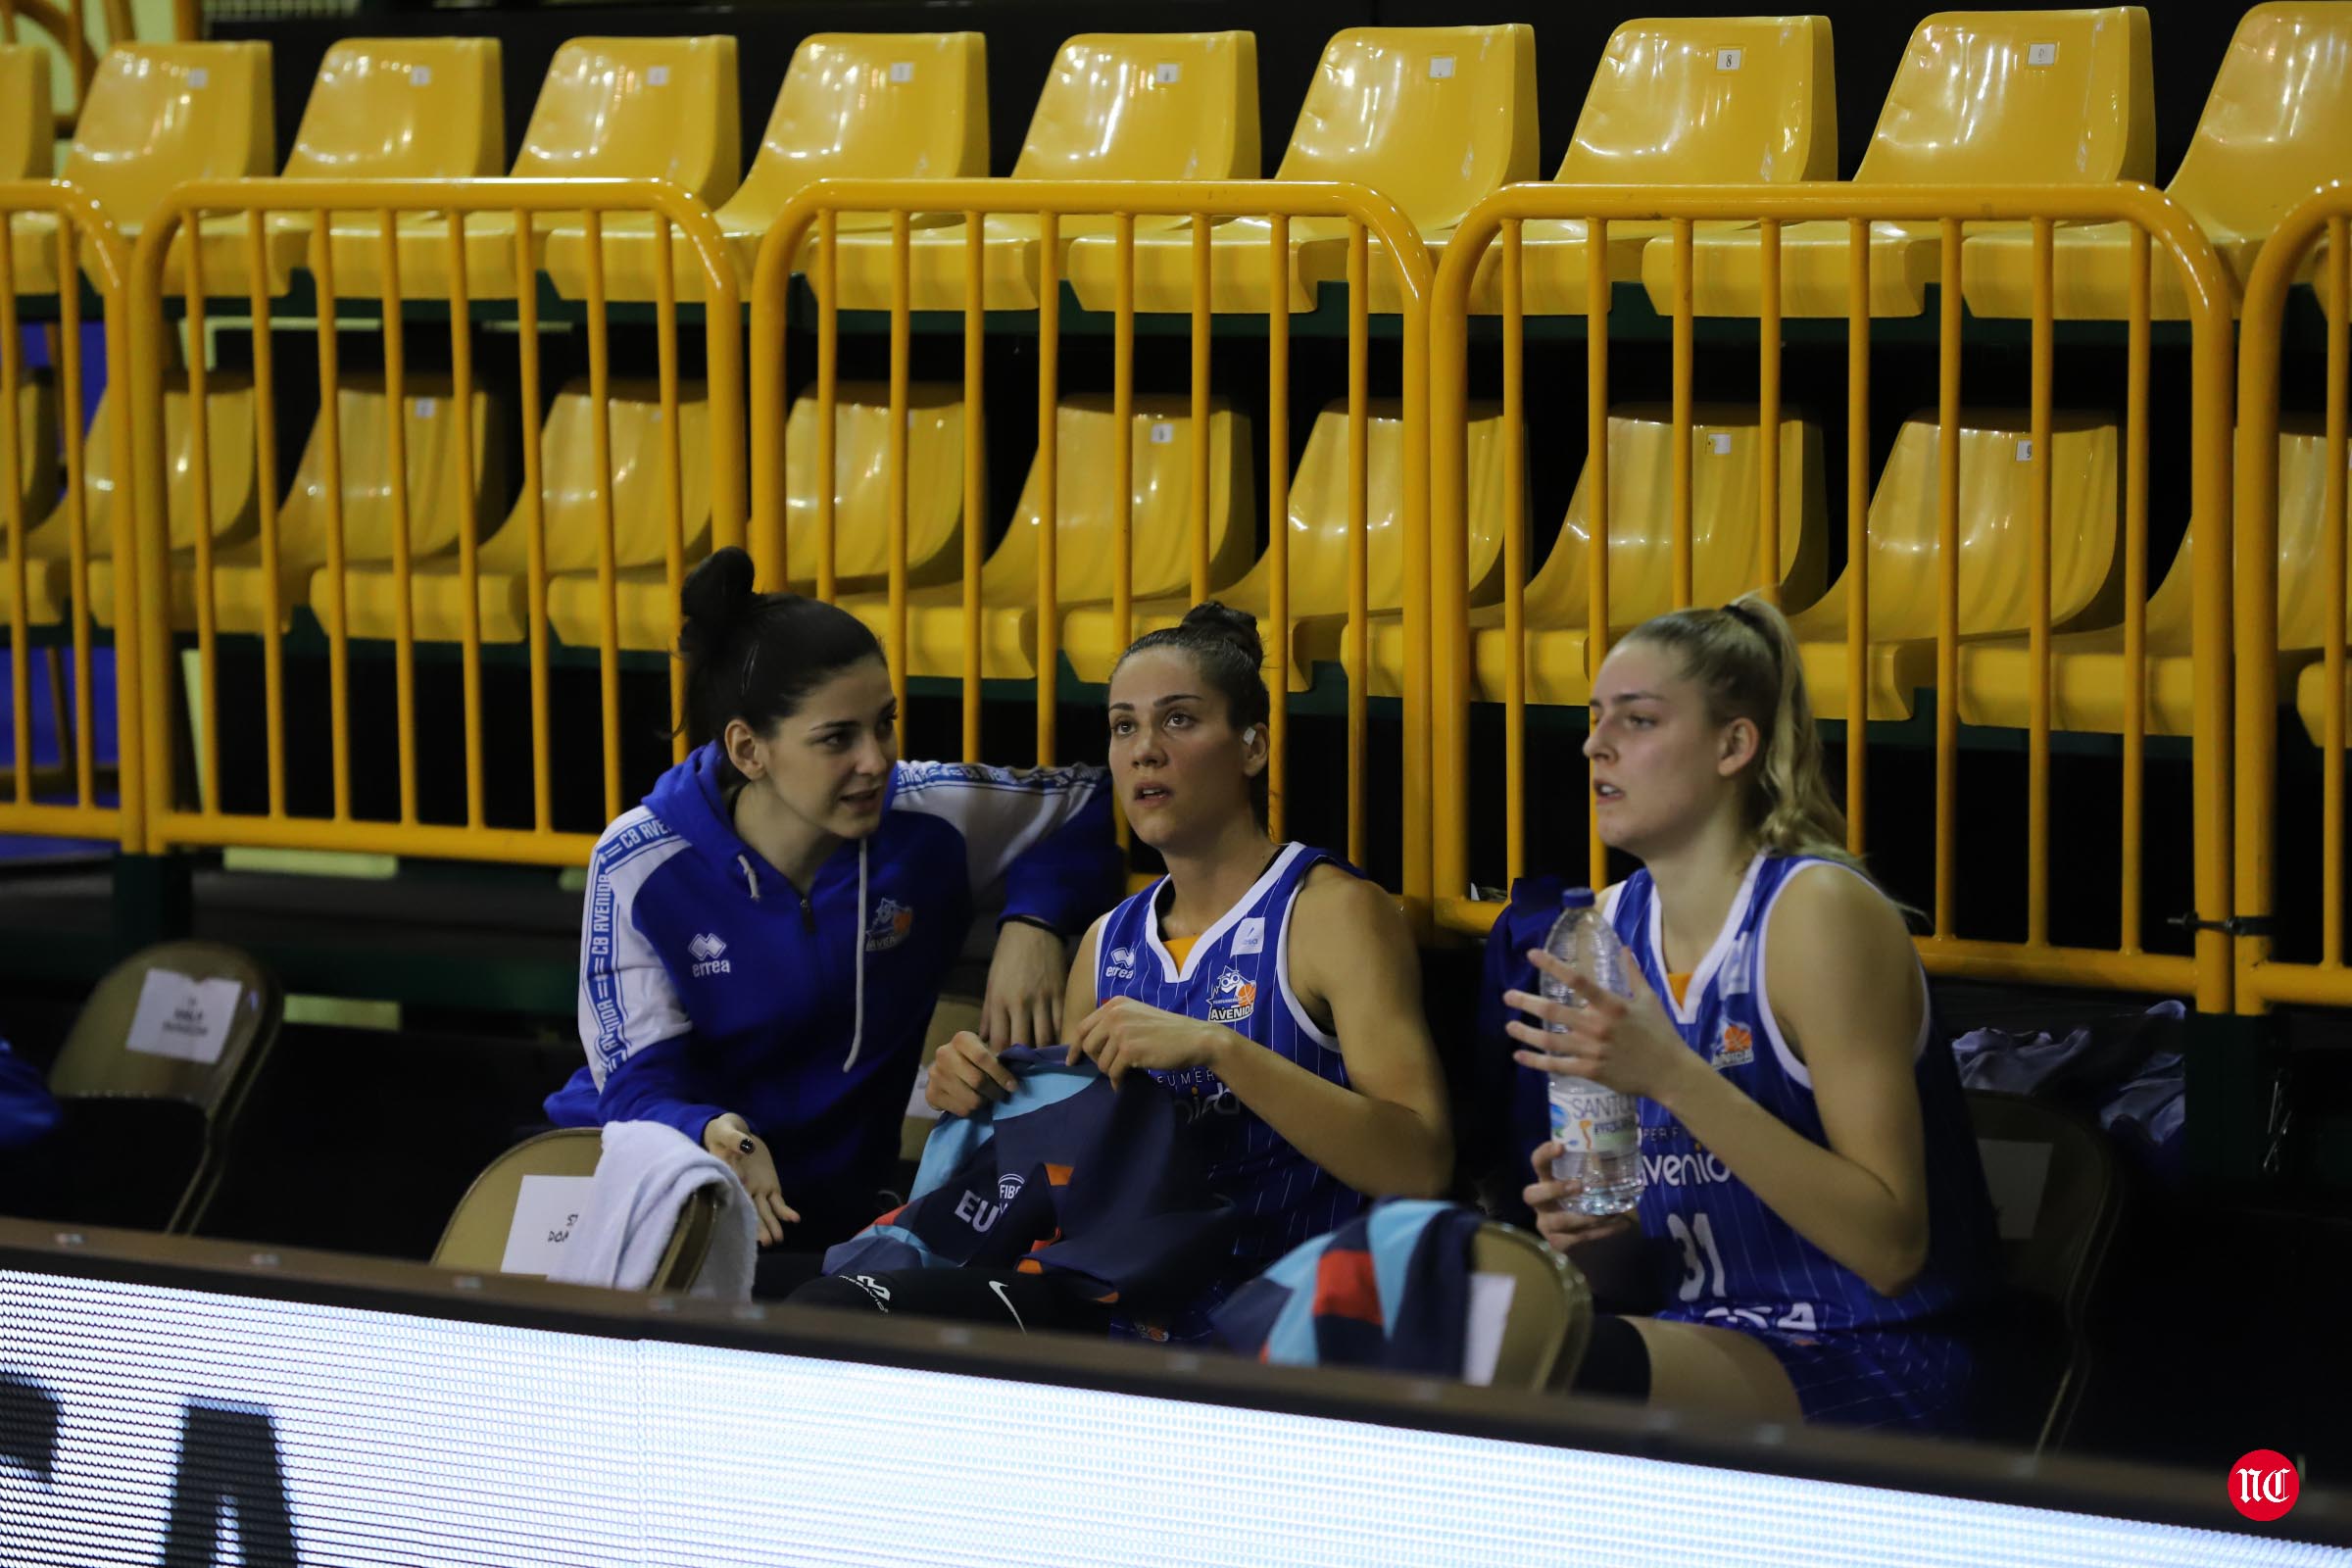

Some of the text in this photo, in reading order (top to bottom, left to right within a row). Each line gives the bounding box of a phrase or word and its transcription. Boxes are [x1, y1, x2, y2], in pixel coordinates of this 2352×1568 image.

[1725, 54, 1733, 69] 8
[618, 828, 642, 849] CB
[591, 873, 612, 956] CB AVENIDA
[692, 959, 731, 978] errea
[954, 1189, 1001, 1233] EU
[1666, 1211, 1727, 1302] 31
